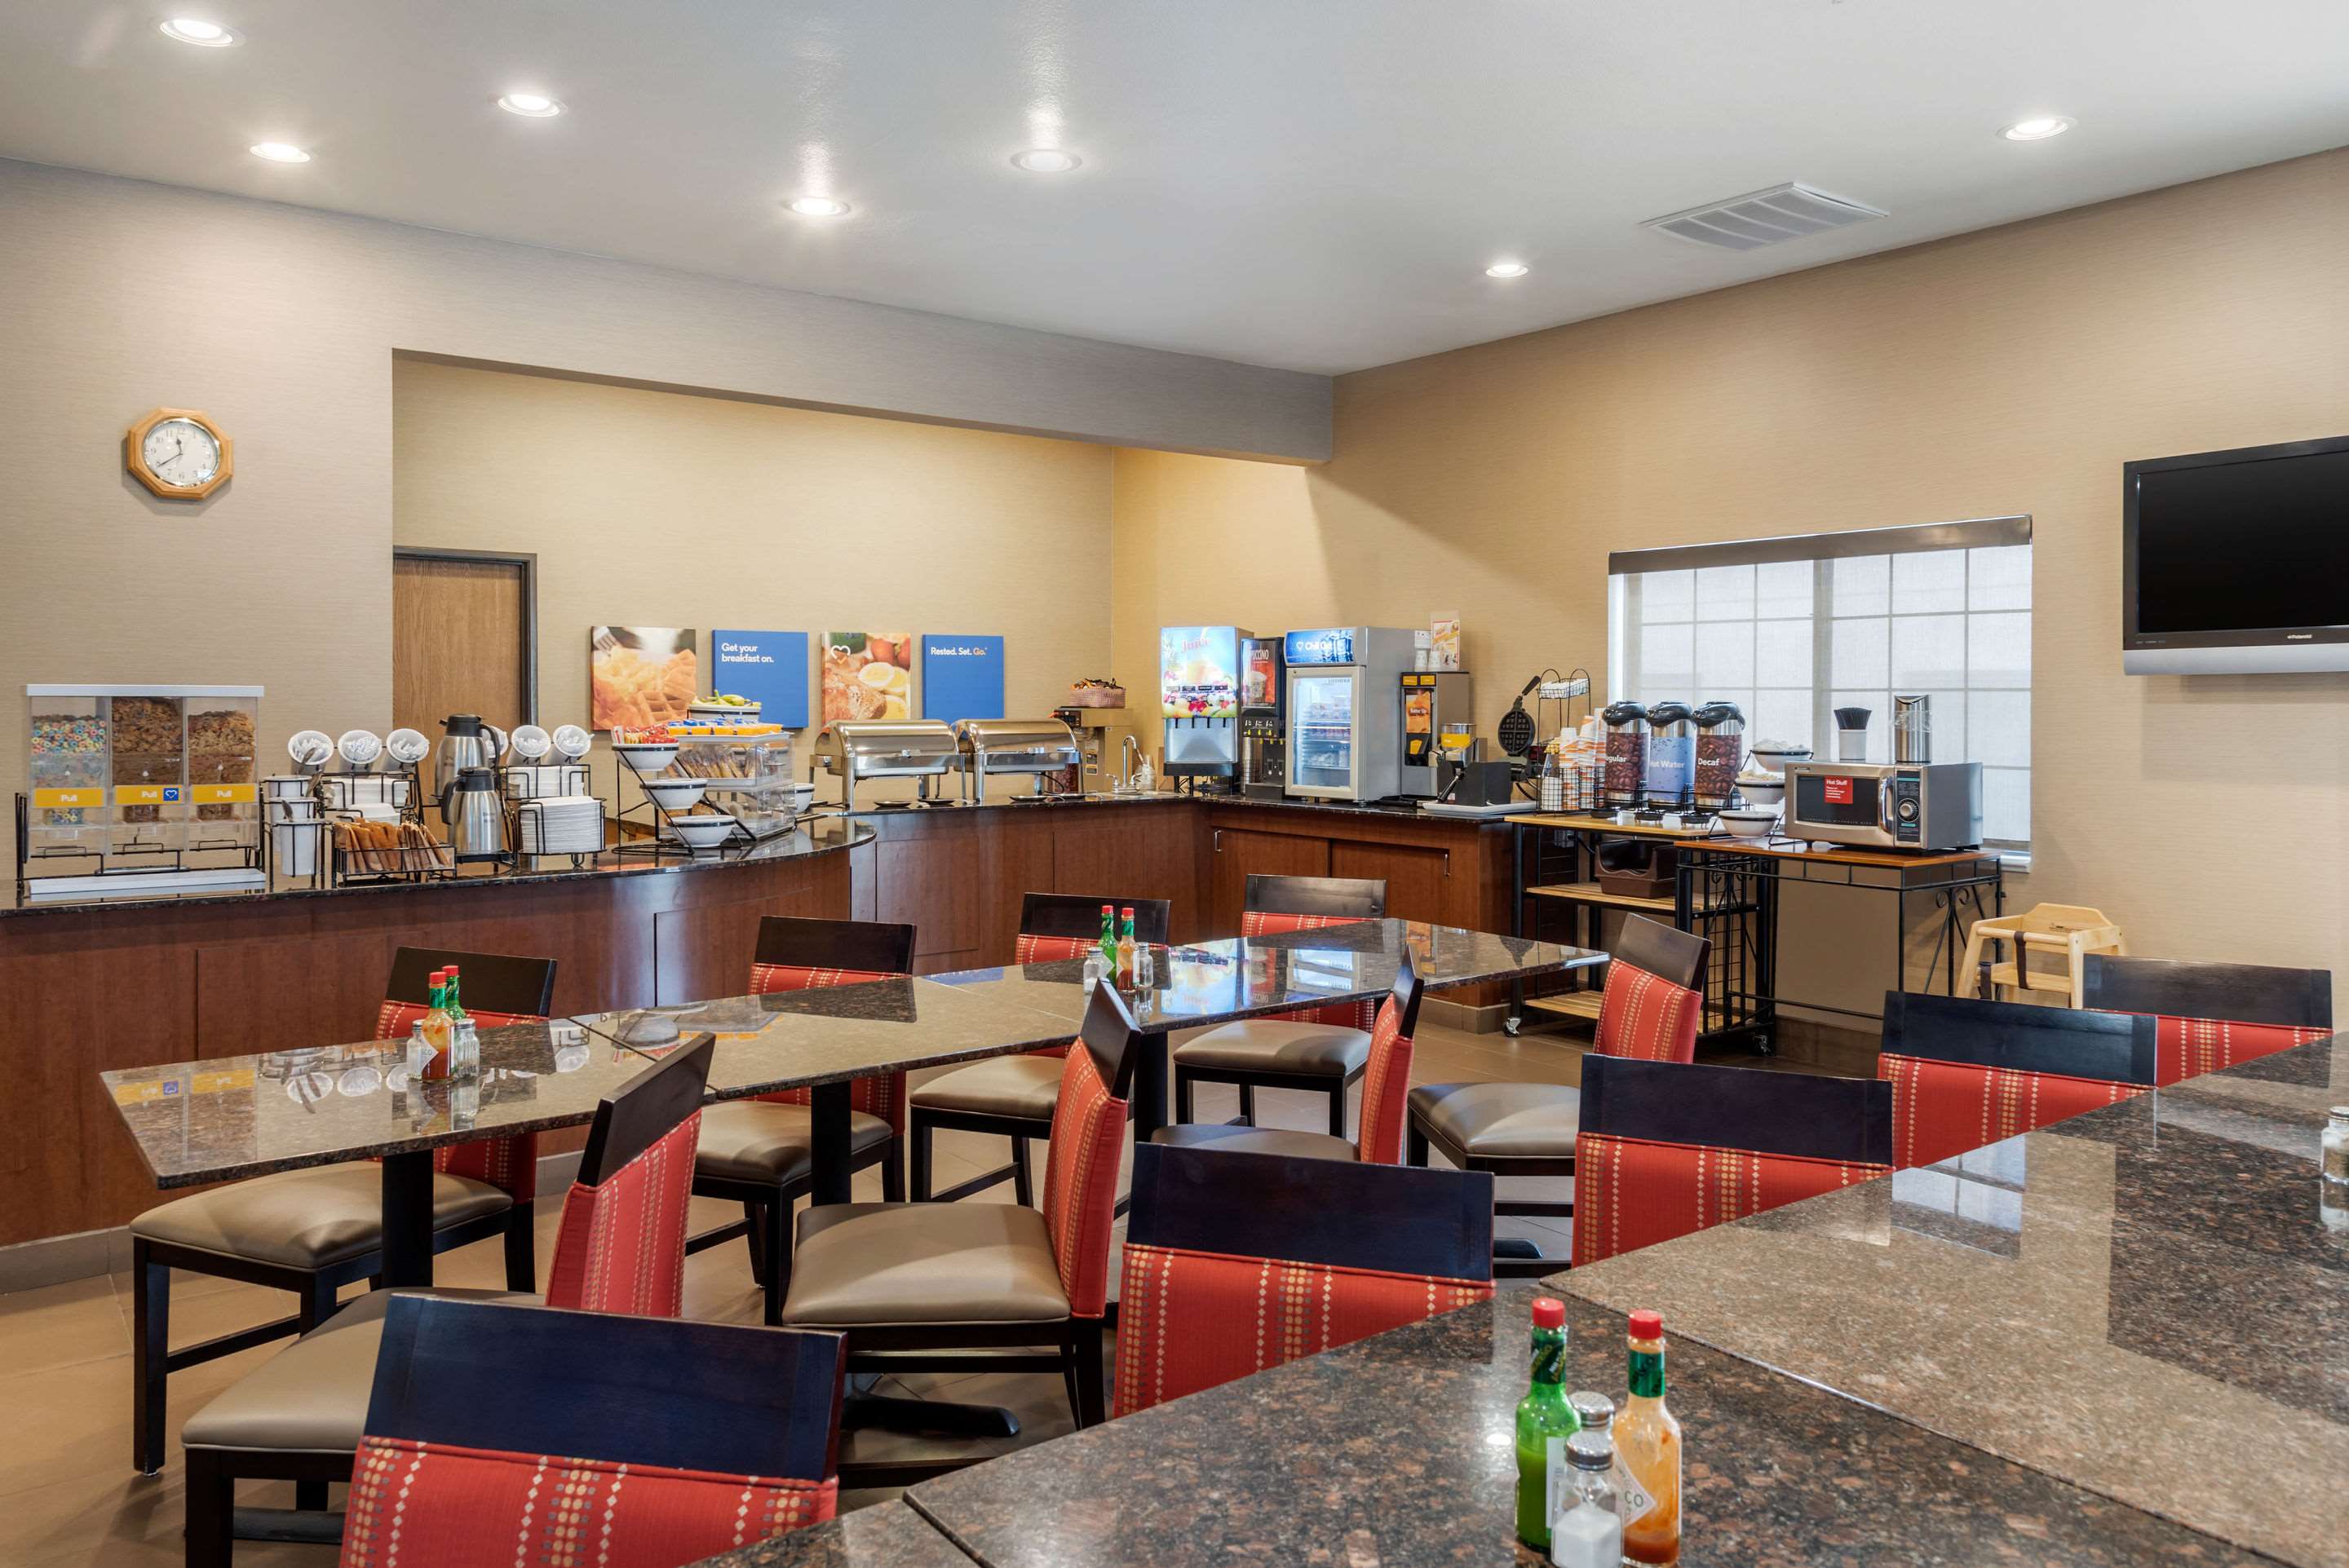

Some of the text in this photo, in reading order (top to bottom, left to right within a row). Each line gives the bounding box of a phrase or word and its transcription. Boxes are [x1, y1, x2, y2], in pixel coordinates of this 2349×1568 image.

[721, 643, 758, 654] Get your
[931, 647, 958, 656] Rested.
[958, 647, 972, 656] Set.
[721, 653, 760, 663] breakfast
[1605, 755, 1627, 763] gular
[1697, 757, 1720, 766] Decaf
[1660, 760, 1684, 769] Water
[142, 790, 157, 798] Pull
[216, 789, 232, 797] Pull
[60, 794, 78, 802] Pull
